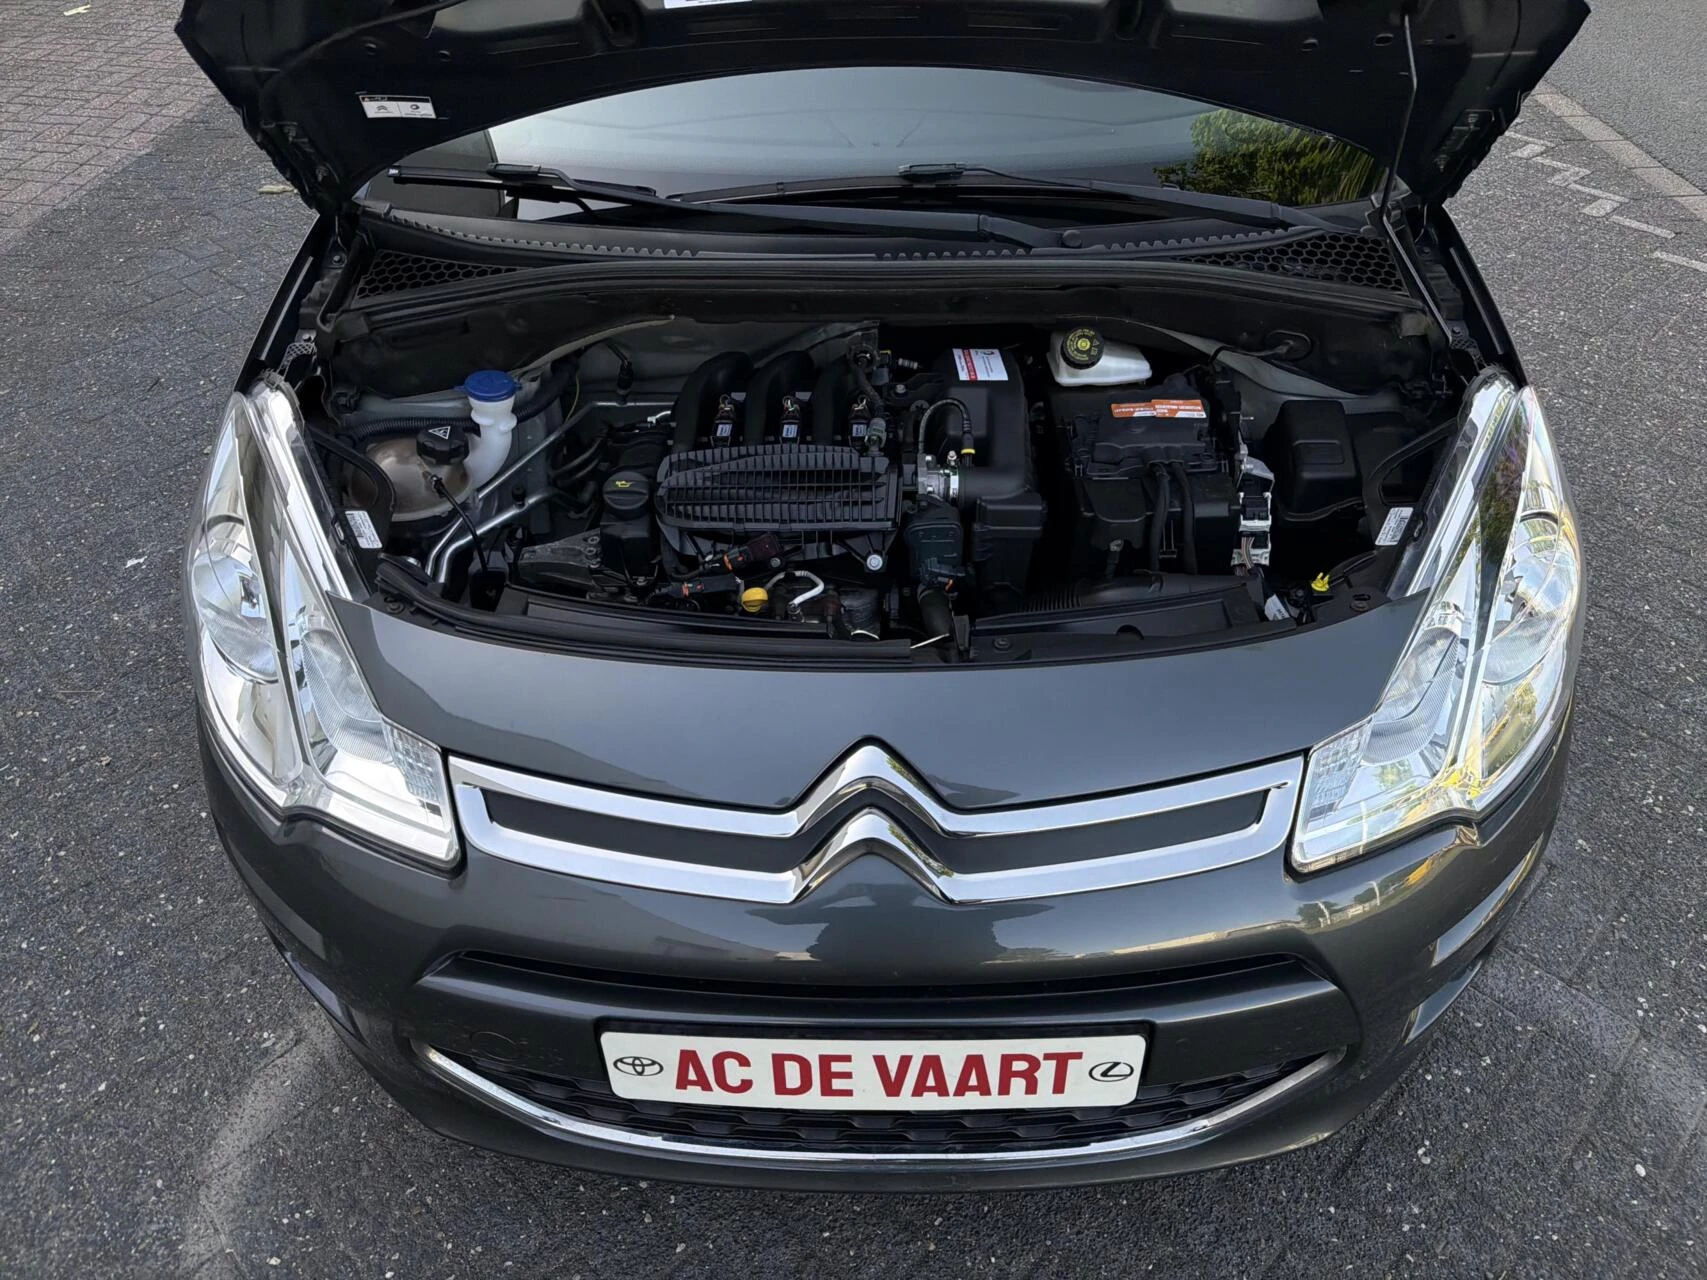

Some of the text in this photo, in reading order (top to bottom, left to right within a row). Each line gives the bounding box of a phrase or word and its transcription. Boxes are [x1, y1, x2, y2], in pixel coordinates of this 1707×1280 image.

[676, 1049, 1083, 1098] AC DE VAART
